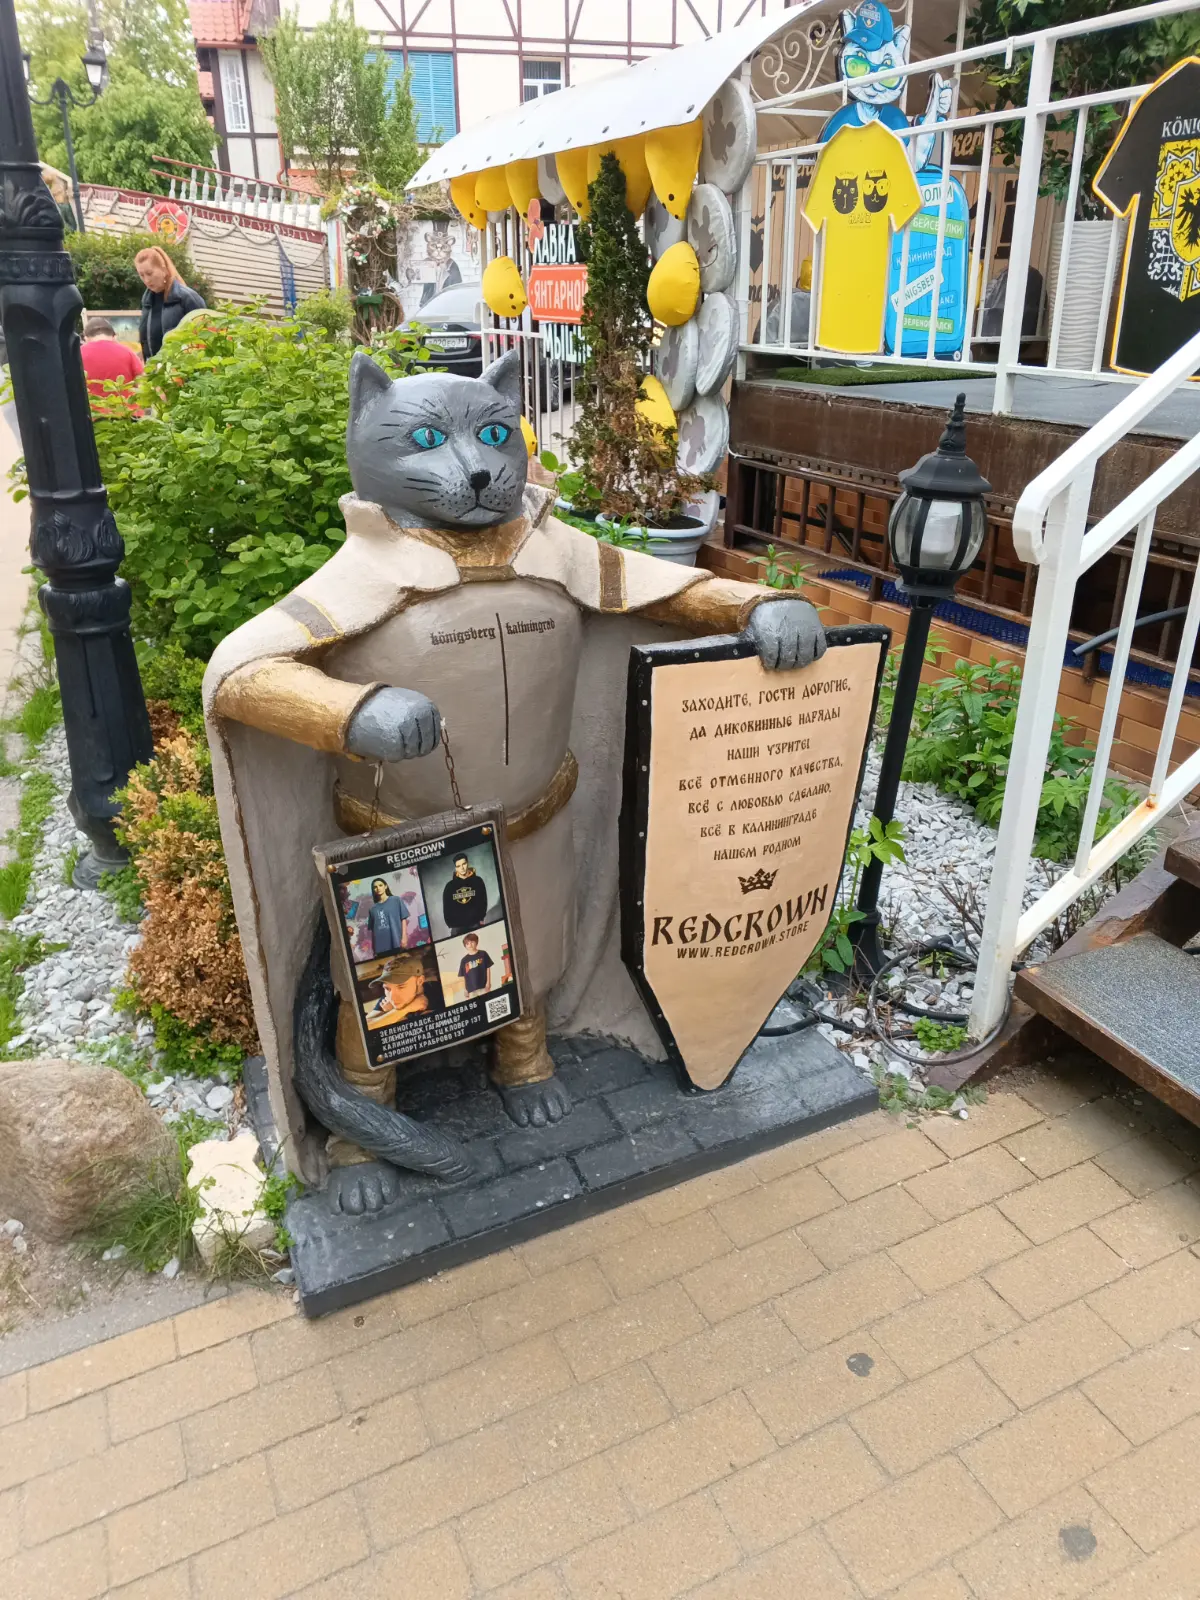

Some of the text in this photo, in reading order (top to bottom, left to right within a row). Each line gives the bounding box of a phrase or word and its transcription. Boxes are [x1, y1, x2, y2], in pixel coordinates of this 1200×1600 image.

[913, 216, 963, 234] БЕЙСБЛКИ
[533, 224, 576, 263] ЛАВКА
[682, 693, 752, 713] ЗАХОДИТЕ,
[758, 686, 795, 704] ГОСТИ
[689, 706, 840, 740] ДА ДИКОВИННЫЕ НАРЯДЫ
[727, 745, 760, 761] НАШИ
[678, 776, 702, 791] ВСЁ
[710, 768, 783, 789] ОТМЕННОГО
[688, 799, 709, 814] ВСЁ
[716, 801, 724, 812] С
[730, 794, 783, 811] ЛЮБОВЬЮ
[700, 808, 817, 838] ВСЁ В КАЛИНИНГРАДЕ
[386, 840, 445, 864] REDCROWN
[714, 835, 801, 861] НАШЕМ РОДНОМ
[651, 883, 828, 946] REDCROWN
[677, 920, 810, 959] WWW.REDCROWN.STORE
[434, 1005, 468, 1021] ПУГАЧЕВА
[384, 1043, 418, 1059] АЭРОПОРТ
